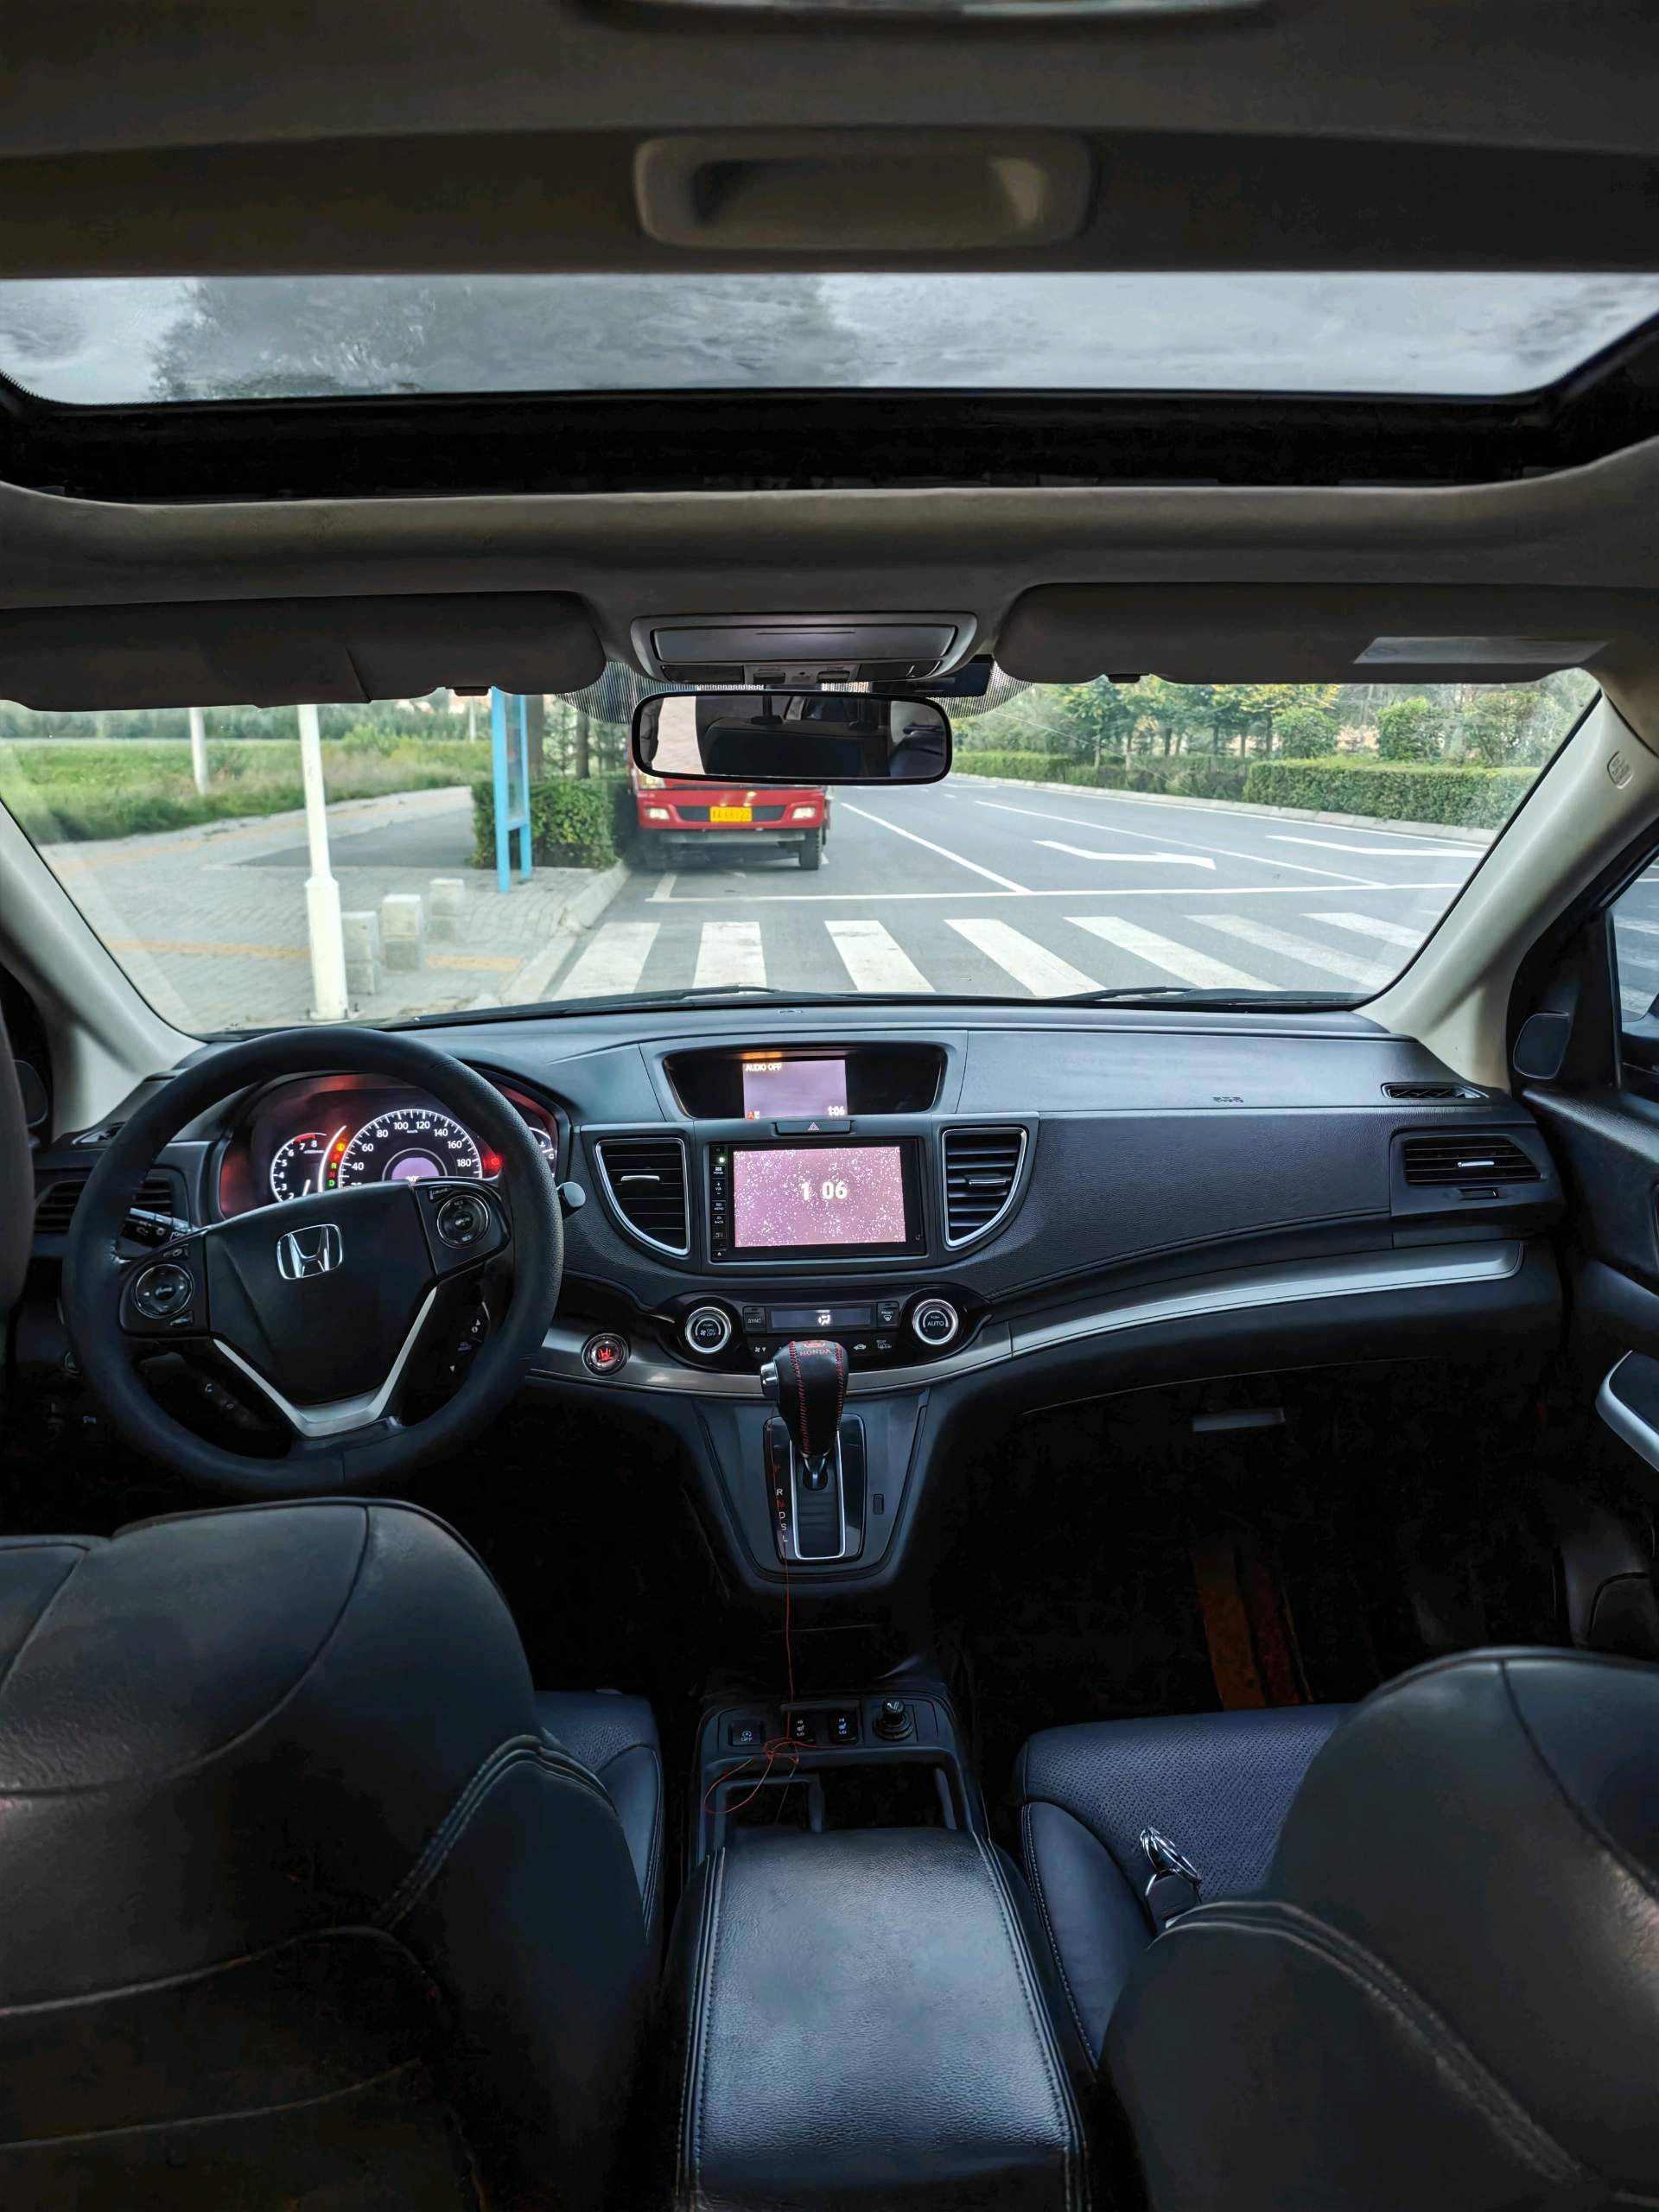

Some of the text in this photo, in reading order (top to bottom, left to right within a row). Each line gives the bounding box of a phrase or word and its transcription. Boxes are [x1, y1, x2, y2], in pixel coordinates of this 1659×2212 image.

[746, 1063, 766, 1071] AUDIO
[828, 1106, 845, 1116] 1:06
[376, 1129, 388, 1138] 80
[361, 1143, 373, 1152] 60
[352, 1162, 364, 1171] 40
[800, 1348, 832, 1357] HONDA
